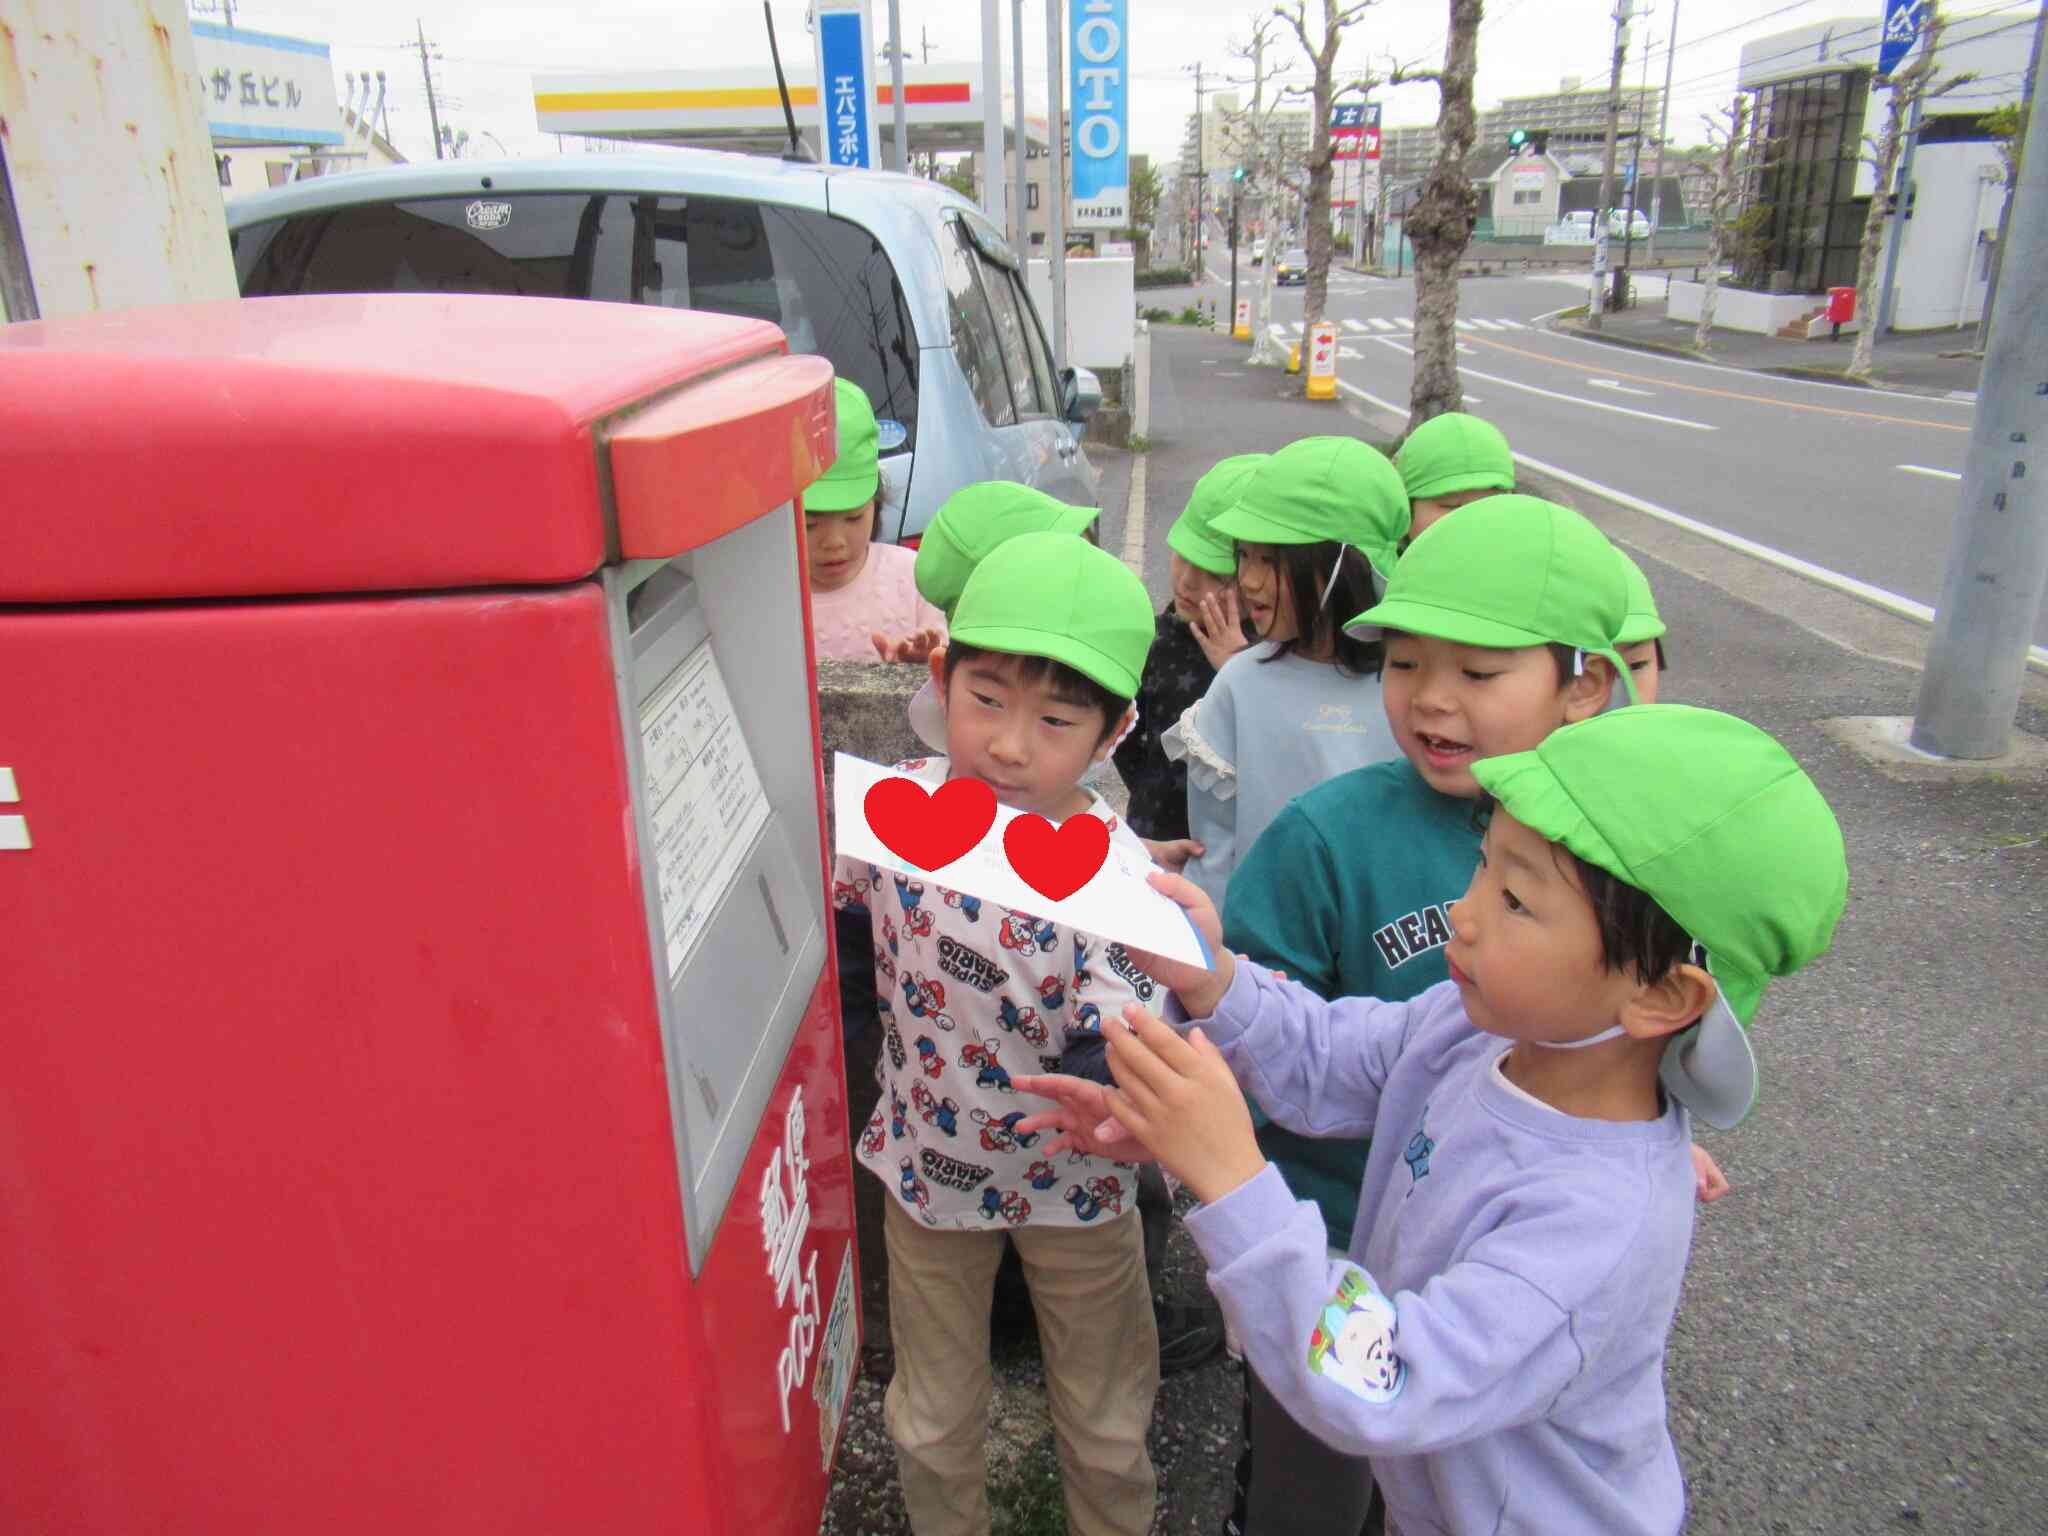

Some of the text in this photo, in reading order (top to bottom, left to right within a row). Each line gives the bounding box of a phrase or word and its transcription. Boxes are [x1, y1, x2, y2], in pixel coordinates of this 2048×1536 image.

[1077, 0, 1121, 158] OTO
[936, 935, 1010, 985] MARIO
[1373, 901, 1456, 969] HEA
[936, 956, 994, 993] SUPER
[920, 1147, 994, 1183] MARIO
[921, 1166, 976, 1192] SUPER
[778, 1250, 820, 1433] POST
